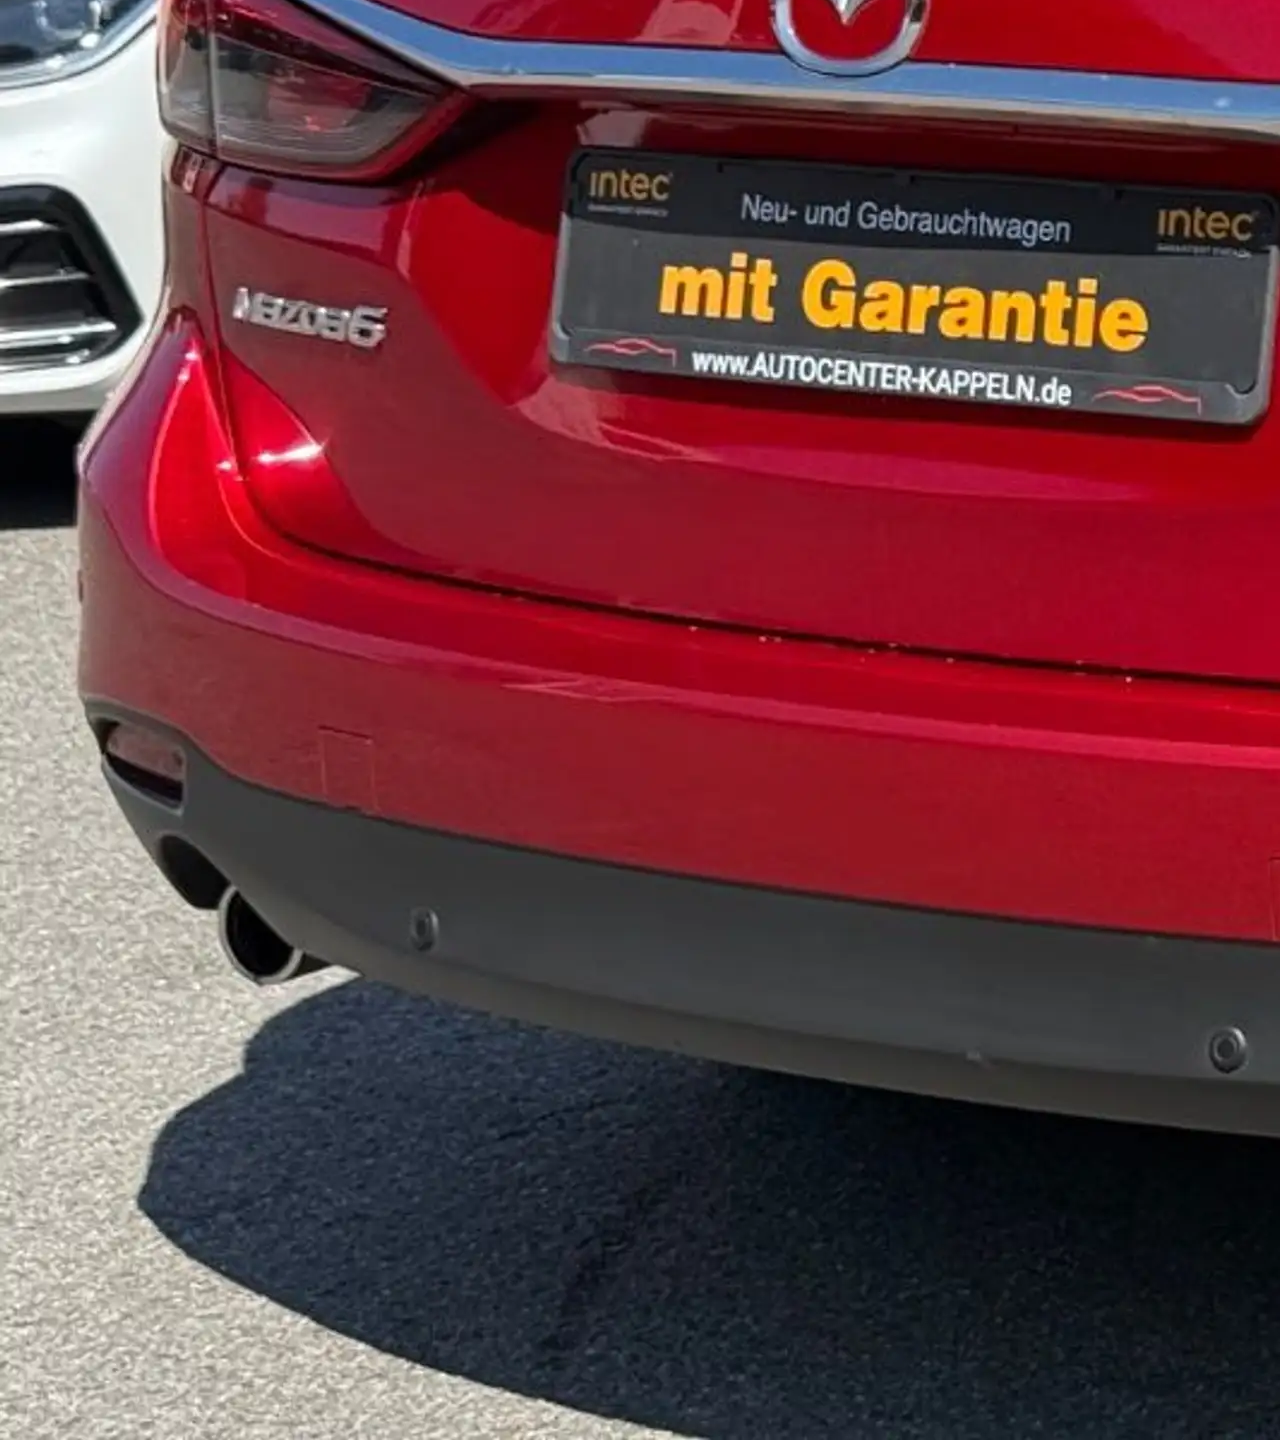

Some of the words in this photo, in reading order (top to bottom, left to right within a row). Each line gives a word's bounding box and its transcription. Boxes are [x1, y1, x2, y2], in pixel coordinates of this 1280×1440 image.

[589, 169, 670, 200] intec
[741, 193, 797, 223] Neu-
[805, 201, 851, 228] und
[857, 201, 1071, 248] Gebrauchtwagen
[1157, 206, 1254, 241] intec
[659, 252, 778, 323] mit
[802, 258, 1149, 352] Garantie
[691, 350, 1072, 406] www.AUTOCENTER-KAPPELN.de
